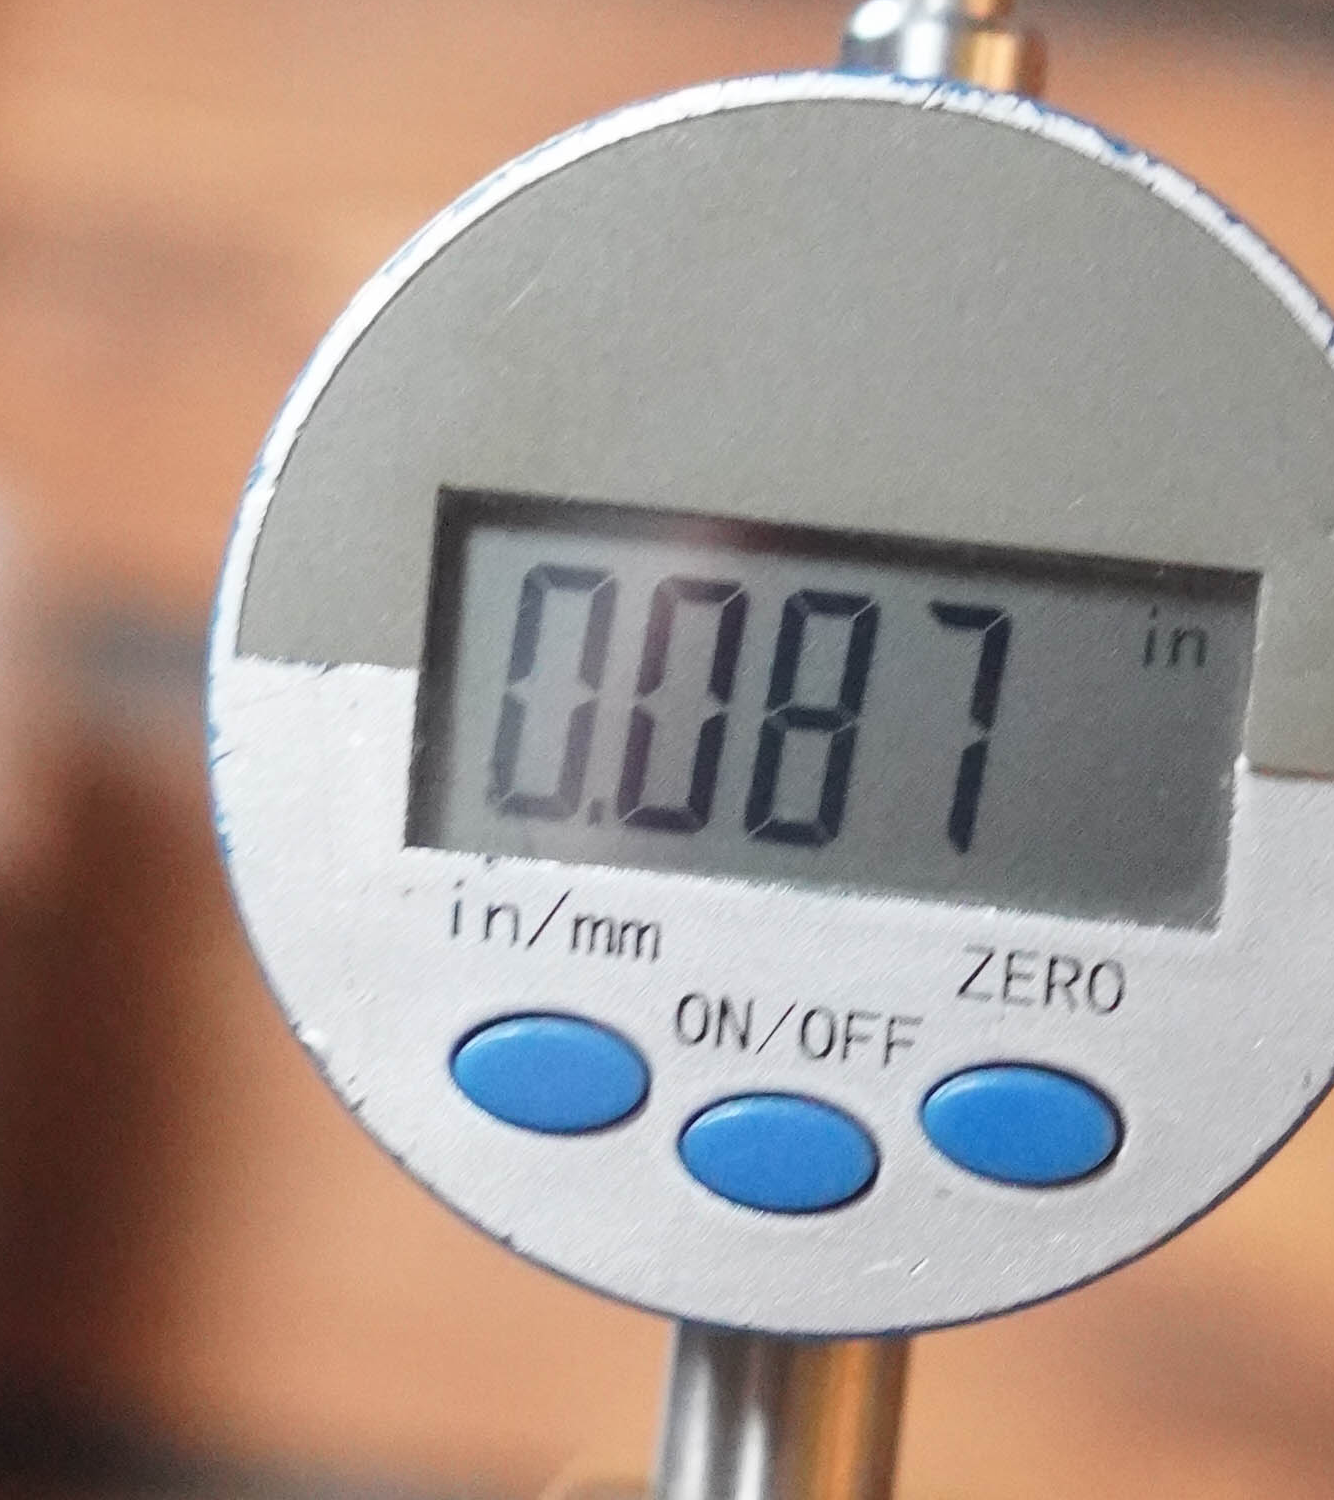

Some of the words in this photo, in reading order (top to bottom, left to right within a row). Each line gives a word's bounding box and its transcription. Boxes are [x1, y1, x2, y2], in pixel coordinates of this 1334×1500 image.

[487, 564, 1012, 853] 0.087
[1141, 610, 1209, 668] in
[450, 885, 661, 962] in/mm
[956, 946, 1127, 1015] ZERO
[676, 993, 925, 1067] ON/OFF
